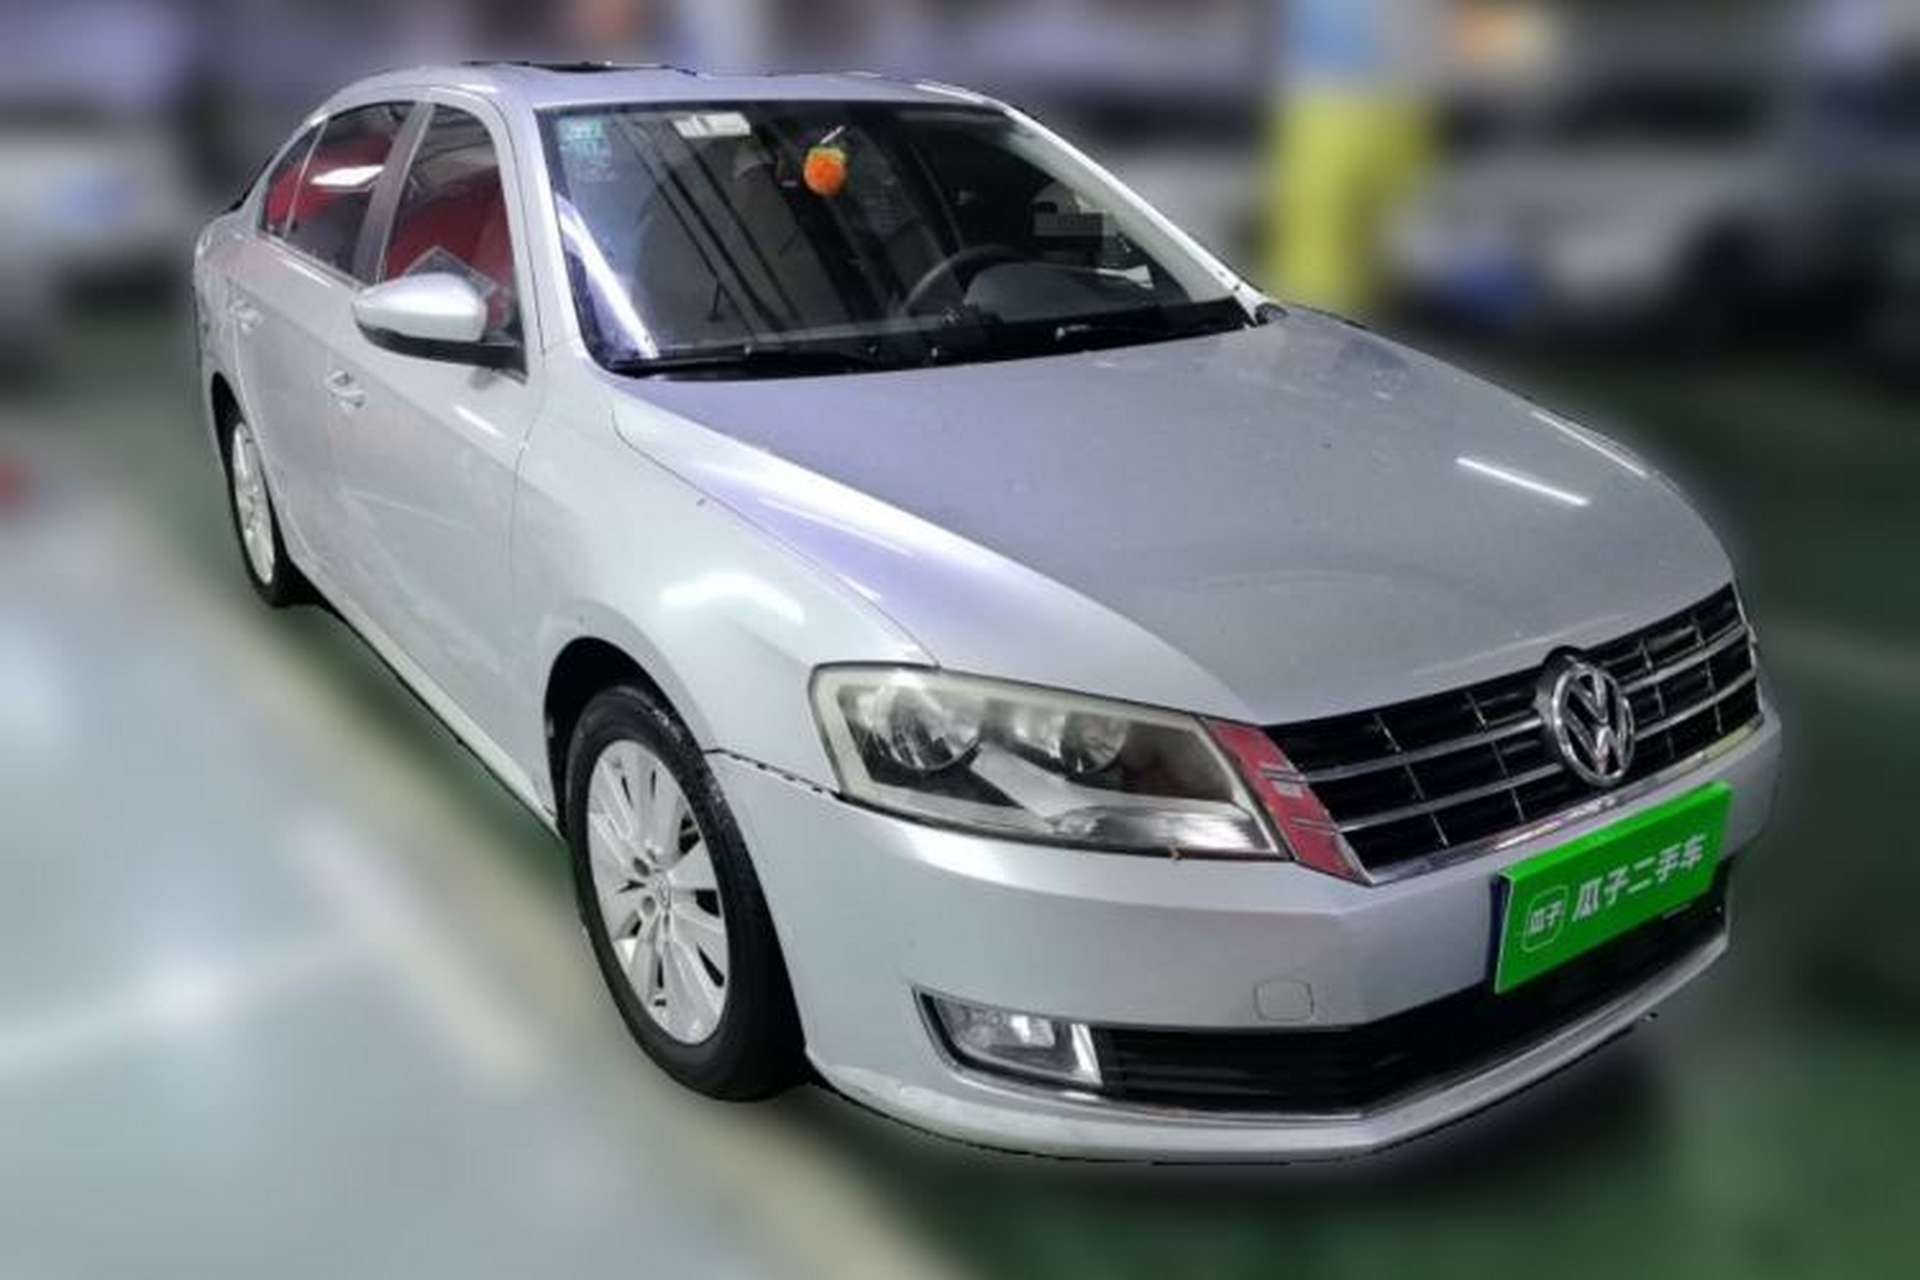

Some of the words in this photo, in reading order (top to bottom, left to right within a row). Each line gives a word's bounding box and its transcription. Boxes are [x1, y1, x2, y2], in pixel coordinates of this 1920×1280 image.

[1572, 834, 1707, 922] 瓜子二手车
